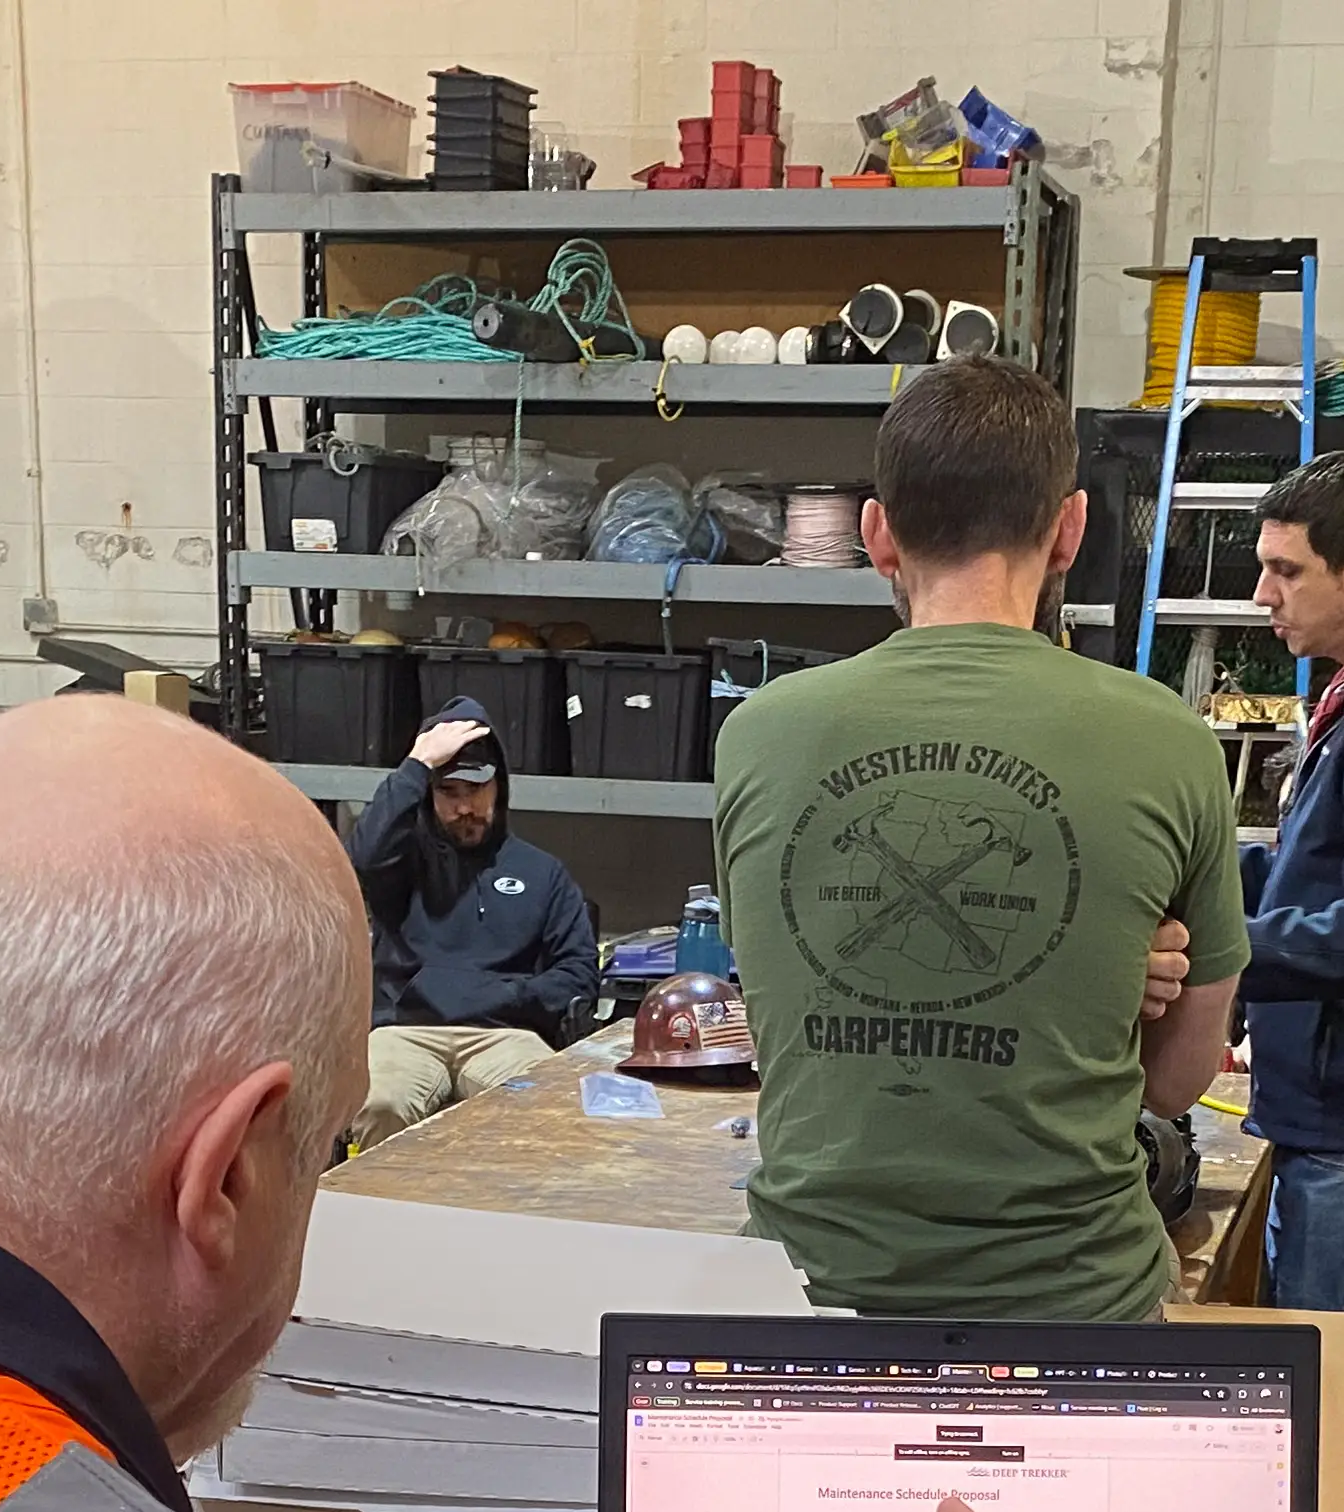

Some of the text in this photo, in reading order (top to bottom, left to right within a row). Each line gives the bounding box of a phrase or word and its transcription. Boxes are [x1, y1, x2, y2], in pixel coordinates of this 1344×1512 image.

[819, 742, 1061, 810] WESTERN STATES
[818, 885, 881, 902] LIVE BETTER
[959, 890, 1037, 913] WORK UNION
[803, 1013, 1020, 1068] CARPENTERS
[992, 1468, 1068, 1479] DEEP TREKKER
[817, 1487, 1000, 1502] Maintenance Schedule Proposal
